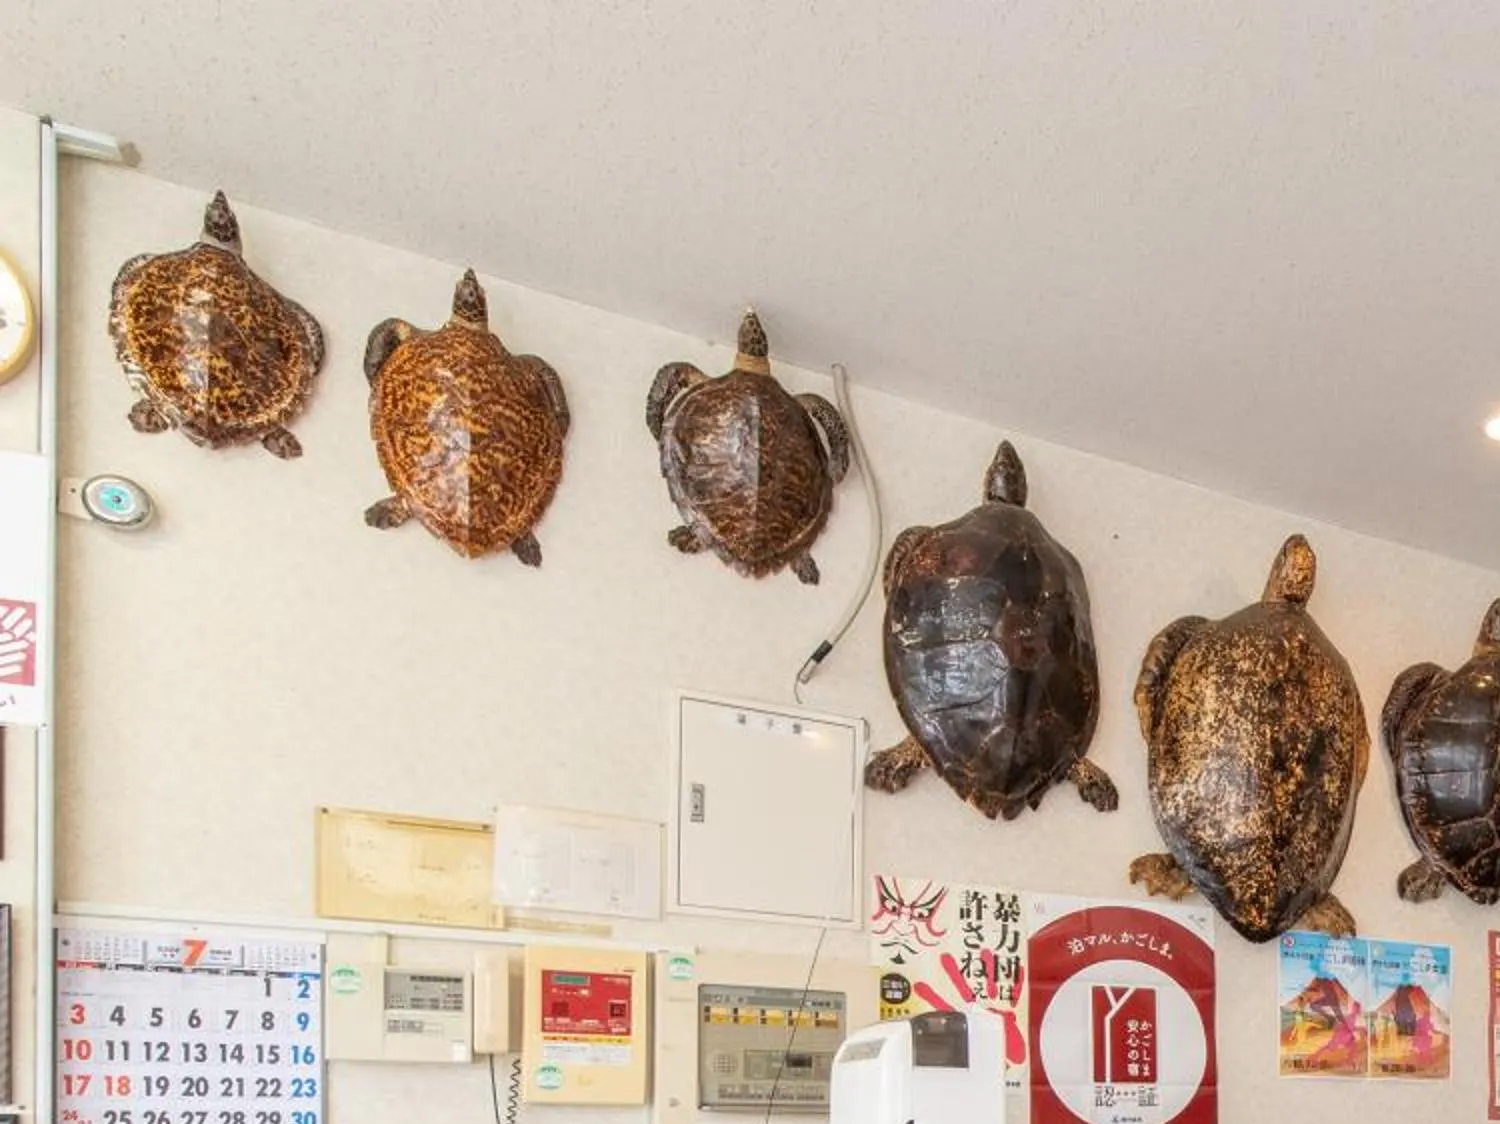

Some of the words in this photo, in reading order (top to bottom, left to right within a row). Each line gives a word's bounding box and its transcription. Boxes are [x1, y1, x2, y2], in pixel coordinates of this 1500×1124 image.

[183, 940, 207, 966] 7
[264, 977, 271, 997] 1
[297, 978, 310, 999] 2
[70, 1004, 85, 1024] 3
[110, 1006, 125, 1026] 4
[150, 1008, 163, 1027] 5
[188, 1009, 201, 1028] 6
[226, 1010, 238, 1029] 7
[262, 1011, 274, 1030] 8
[297, 1012, 309, 1031] 9
[63, 1039, 92, 1061] 10
[106, 1040, 129, 1061] 11
[144, 1042, 170, 1062] 12
[182, 1042, 207, 1062] 13
[220, 1044, 244, 1064] 14
[256, 1044, 280, 1064] 15
[292, 1045, 315, 1065] 16
[63, 1074, 92, 1096] 17
[105, 1076, 130, 1096] 18
[144, 1076, 170, 1096] 19
[182, 1077, 209, 1096] 20
[221, 1077, 244, 1097] 21
[256, 1078, 281, 1097] 22
[292, 1078, 316, 1097] 23
